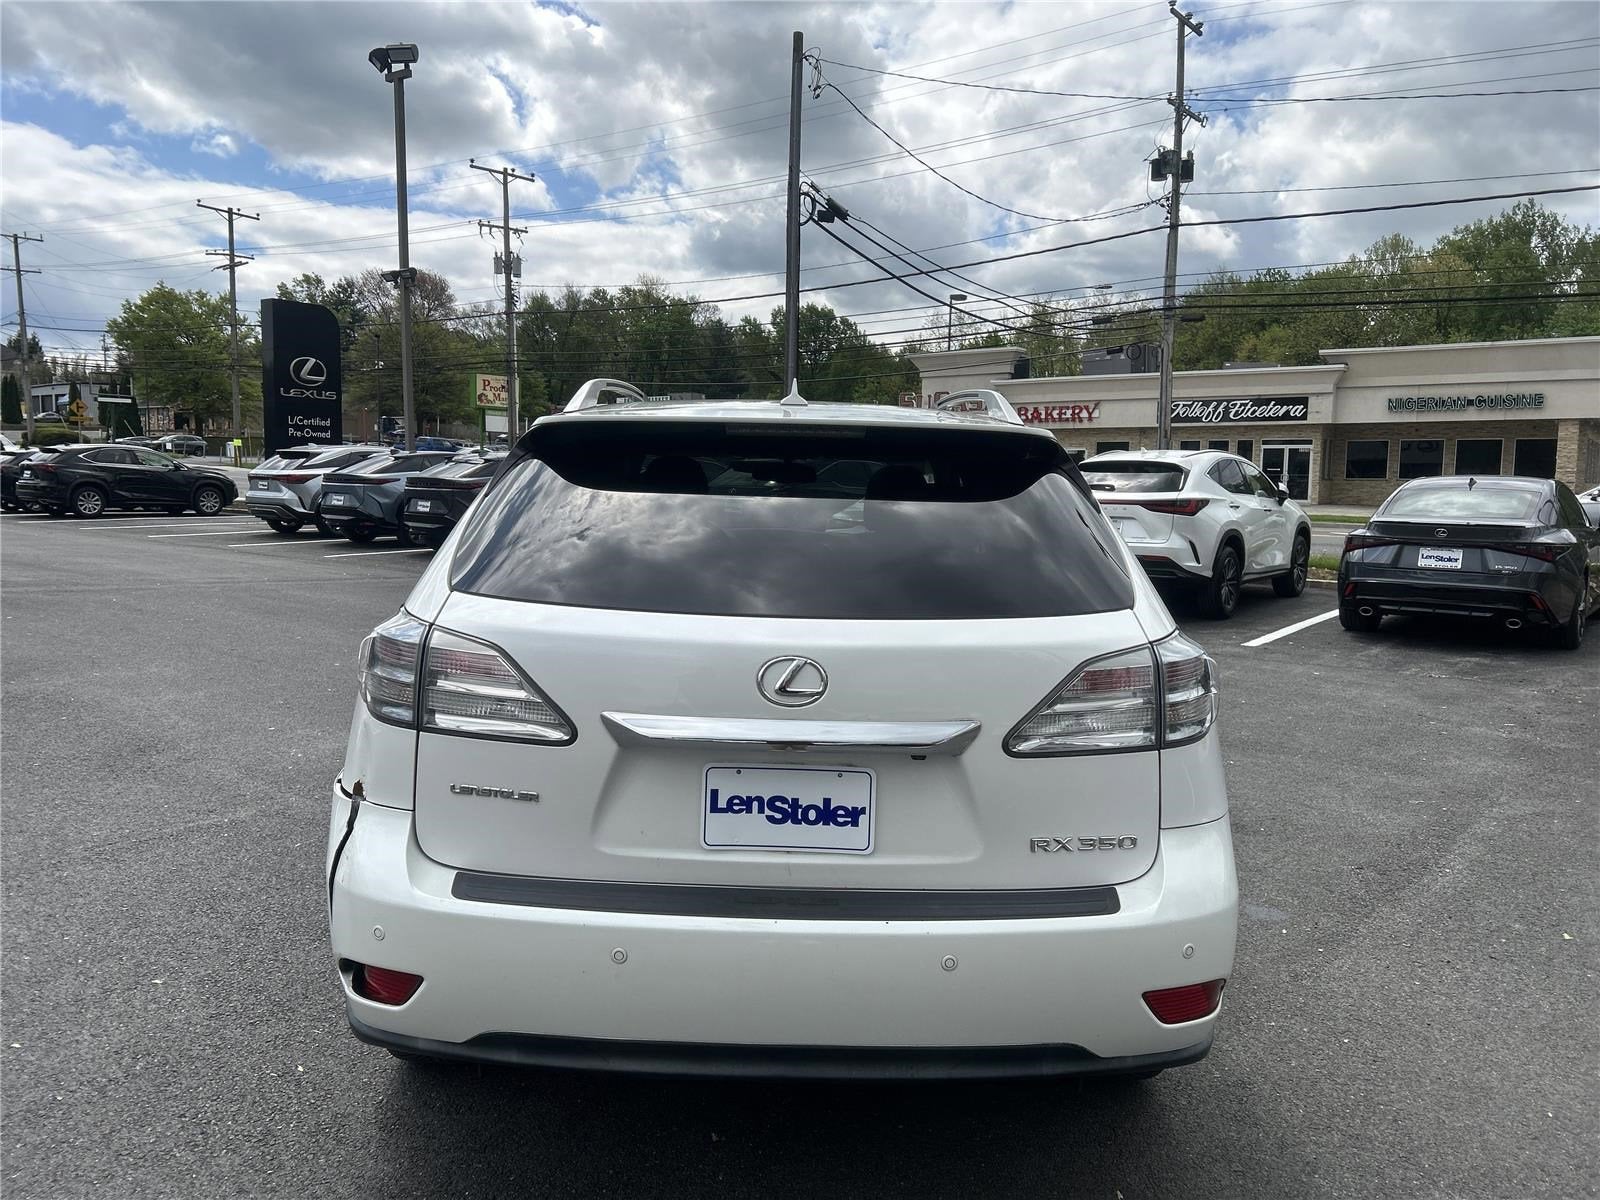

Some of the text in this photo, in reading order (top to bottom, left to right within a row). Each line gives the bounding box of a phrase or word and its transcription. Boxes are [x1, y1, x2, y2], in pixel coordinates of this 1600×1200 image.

[280, 387, 337, 400] LEXUS
[1229, 400, 1307, 420] Etcetera
[1387, 393, 1545, 412] NIGERIAN CUISINE
[288, 415, 331, 427] L/Certified
[1018, 402, 1100, 424] BAKERY
[288, 427, 331, 438] Pre-Owned
